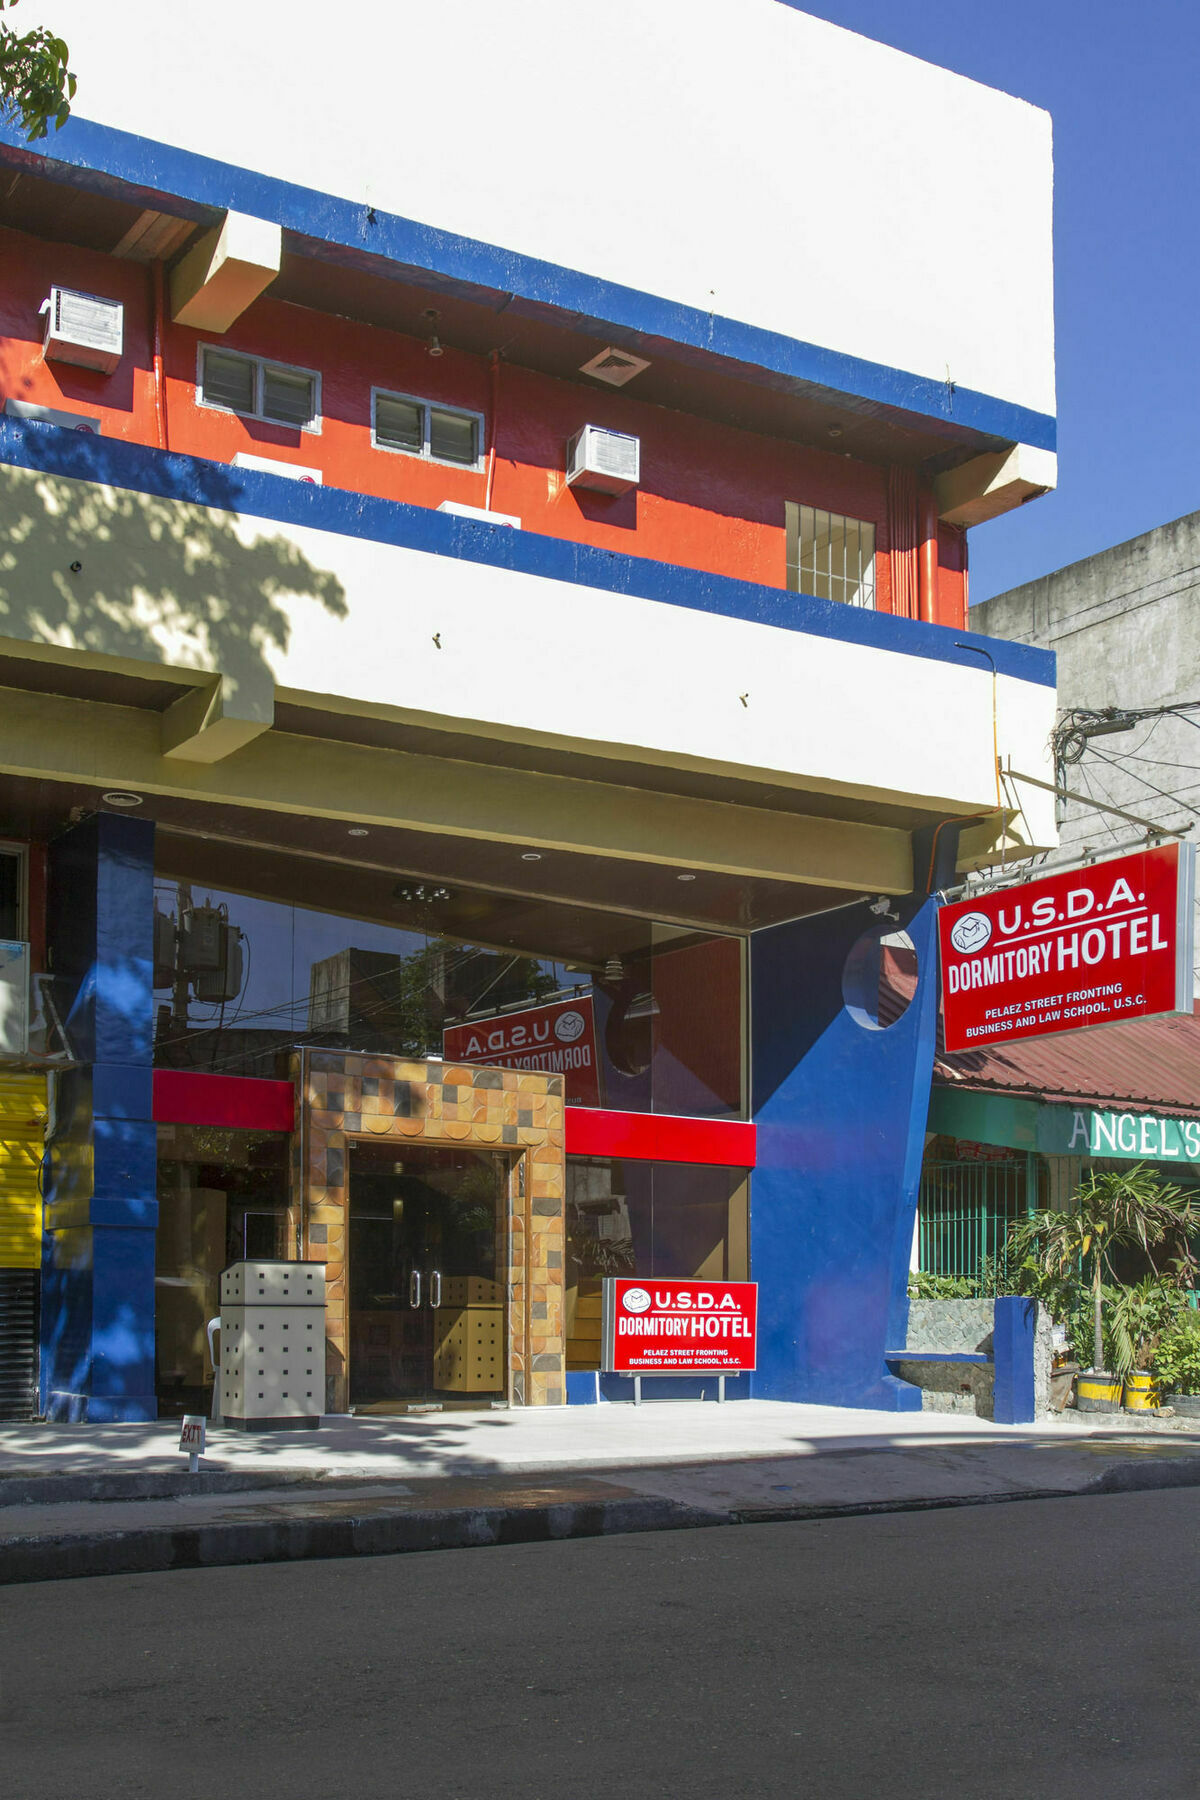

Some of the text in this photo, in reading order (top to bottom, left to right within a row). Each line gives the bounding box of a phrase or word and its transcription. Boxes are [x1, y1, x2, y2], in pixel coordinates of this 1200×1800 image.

[998, 878, 1146, 935] U.S.D.A.
[948, 913, 1168, 994] DORMITORY HOTEL
[966, 994, 1147, 1038] BUSINESS AND LAW SCHOOL, U.S.C.
[985, 983, 1123, 1020] PELAEZ STREET FRONTING
[1068, 1111, 1200, 1158] ANGEL'S
[655, 1291, 741, 1309] U.S.D.A.
[618, 1316, 752, 1338] DORMITORY HOTEL
[629, 1357, 662, 1365] BUSINESS
[694, 1358, 721, 1366] SCHOOL,
[182, 1423, 202, 1443] EXIT
